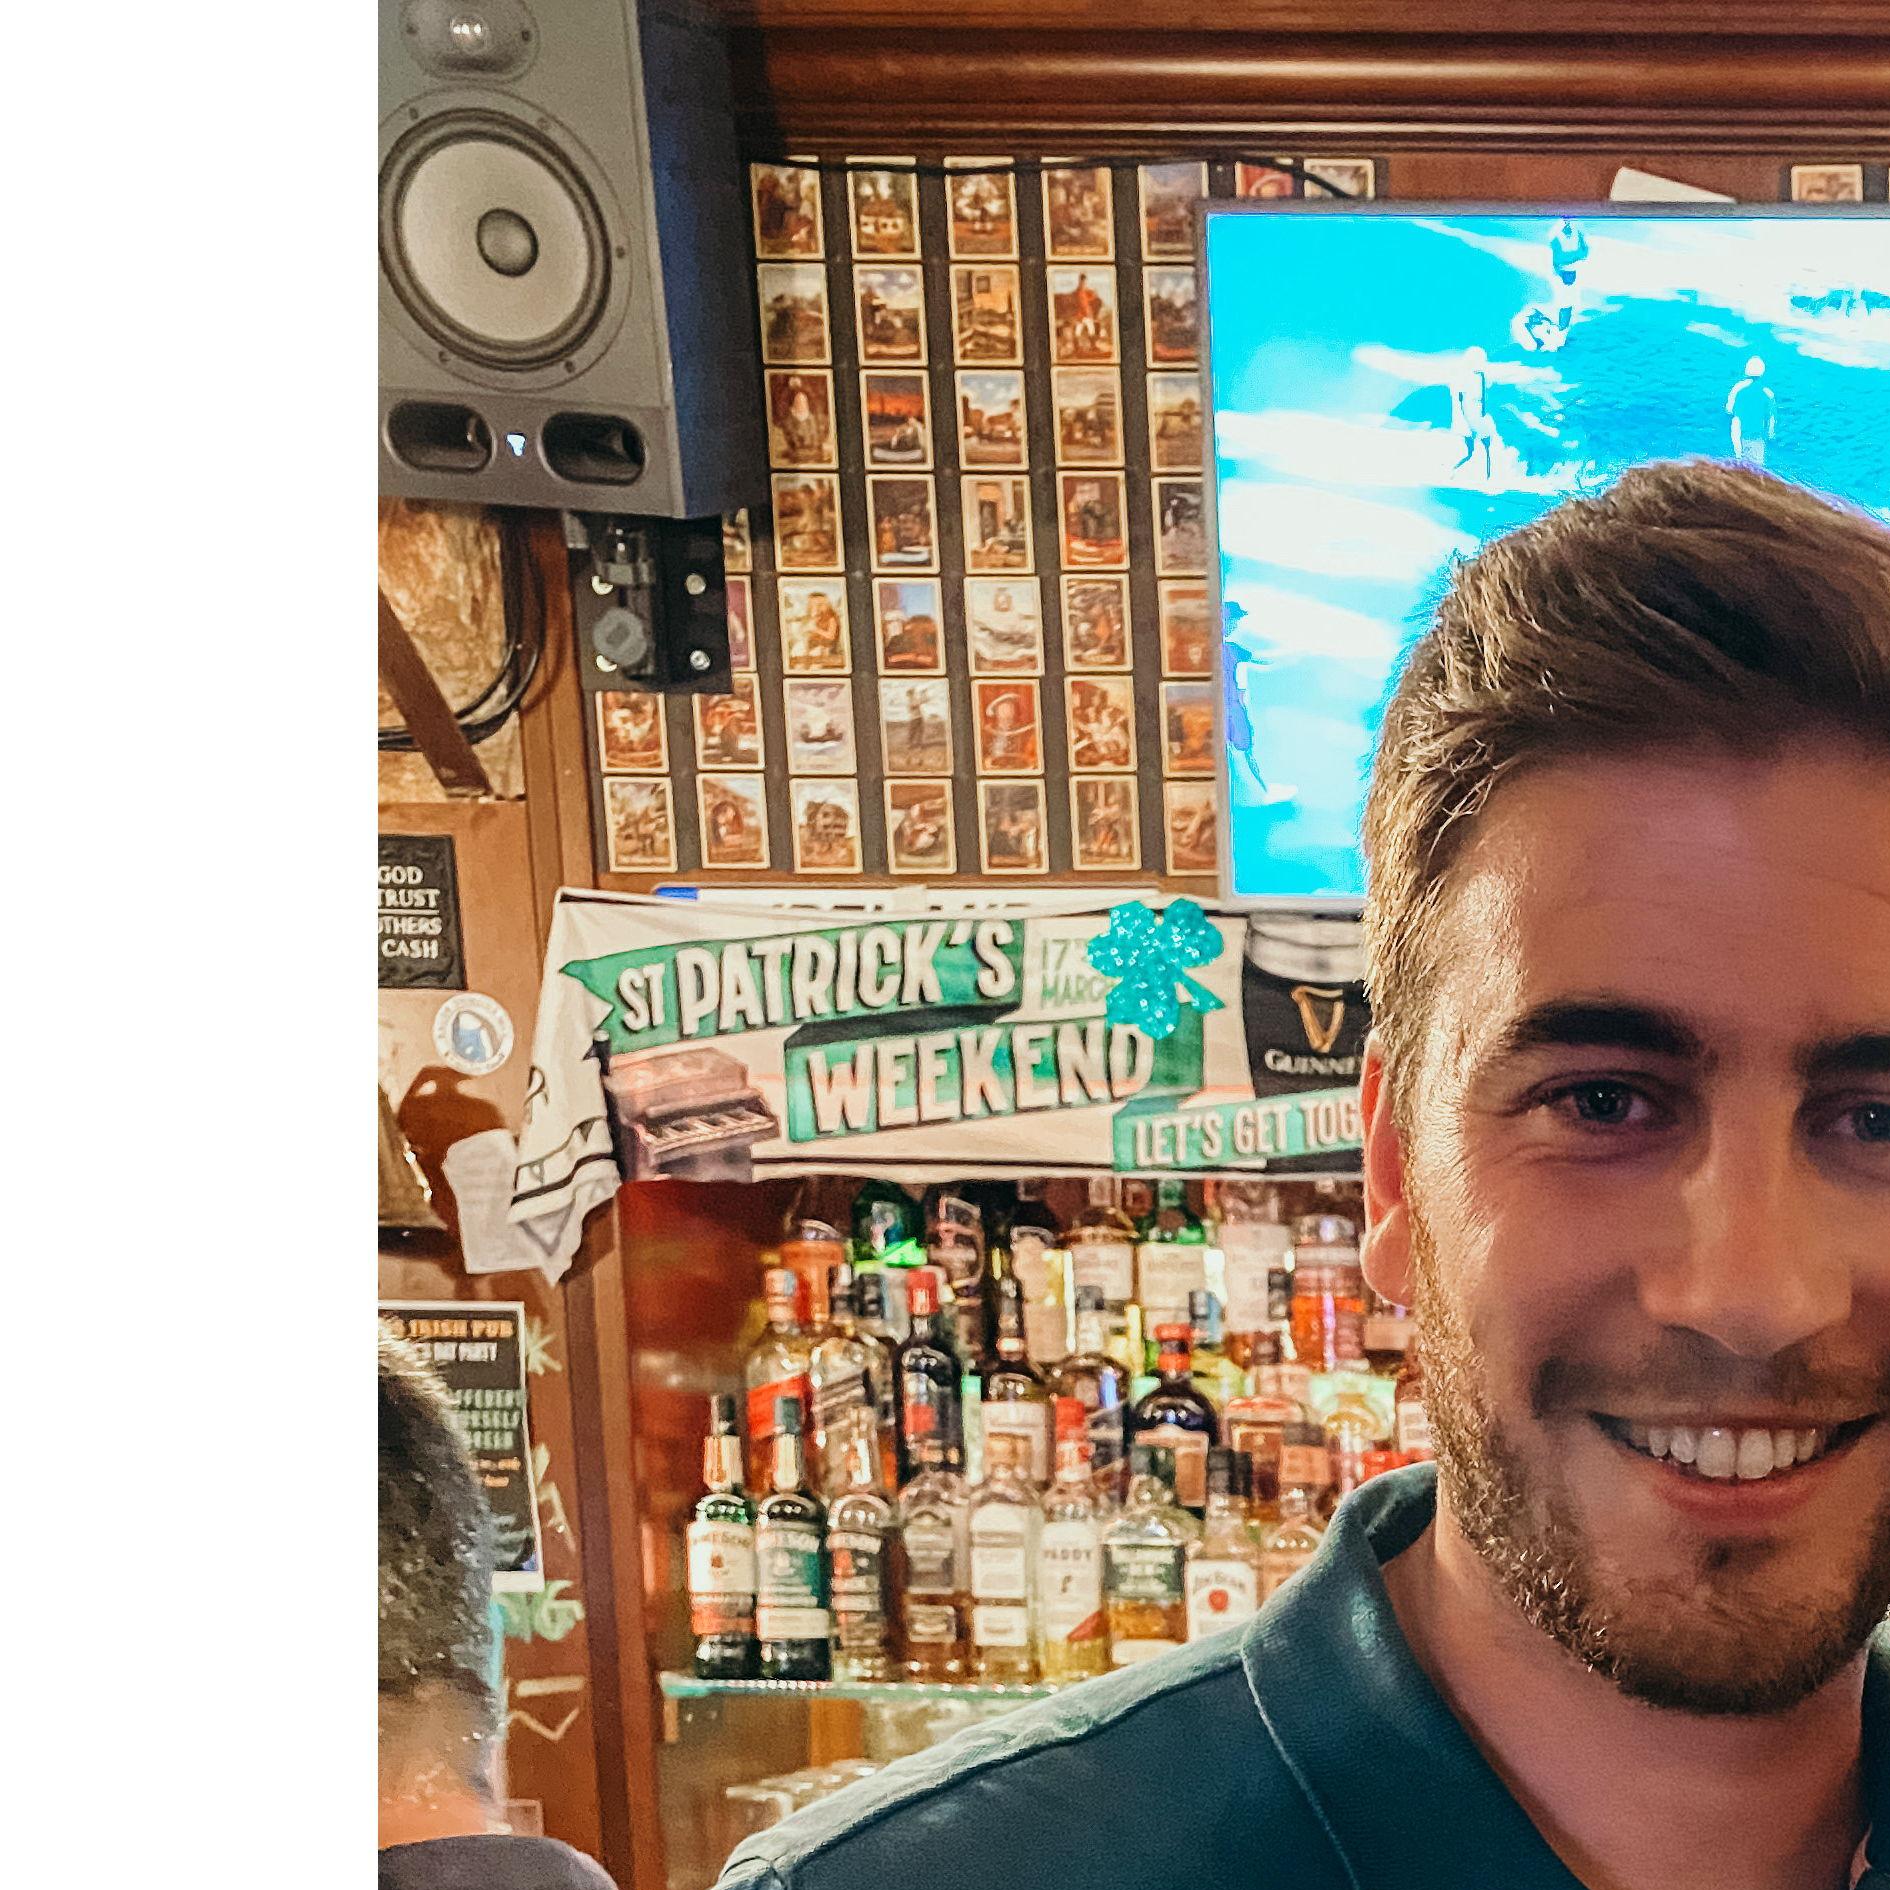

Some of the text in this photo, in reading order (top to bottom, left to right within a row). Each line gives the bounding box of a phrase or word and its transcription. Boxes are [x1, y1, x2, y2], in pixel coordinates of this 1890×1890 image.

[381, 938, 439, 959] CASH
[674, 918, 1016, 1037] PATRICK'S
[1040, 974, 1110, 1010] MARC
[808, 1020, 1155, 1133] WEEKEND
[1134, 1095, 1362, 1168] LET'S GET TOG
